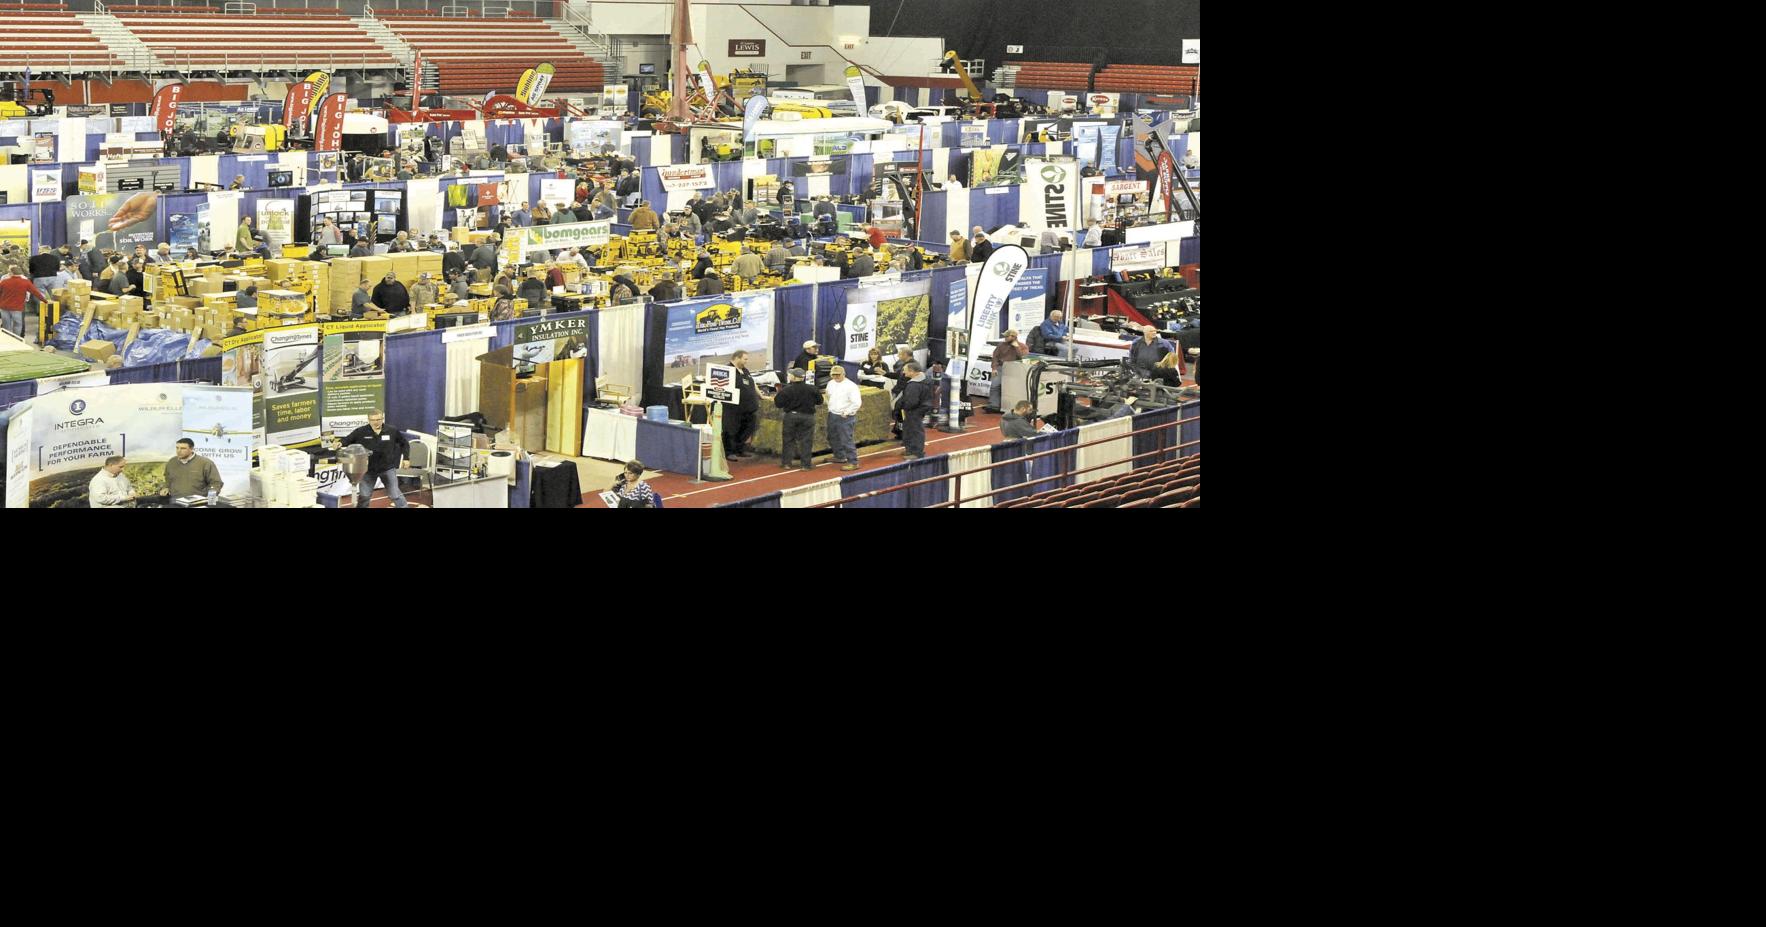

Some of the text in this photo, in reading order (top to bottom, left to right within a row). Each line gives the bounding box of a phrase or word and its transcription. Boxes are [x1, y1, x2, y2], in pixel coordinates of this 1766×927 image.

[801, 52, 811, 60] EXIT
[169, 86, 180, 109] BIG
[301, 83, 311, 104] BIG
[335, 95, 345, 119] BIG
[544, 226, 608, 240] bomgaars
[1005, 263, 1022, 282] STINE
[977, 294, 997, 327] LIBERTY
[530, 320, 585, 334] YMKER
[985, 311, 998, 330] LINK
[532, 330, 569, 341] INSULATION
[850, 333, 868, 343] STINE
[54, 417, 104, 430] INTEGRA
[49, 444, 112, 458] PERFORMANCE
[53, 438, 107, 451] DEPENDABLE
[64, 454, 86, 462] YOUR
